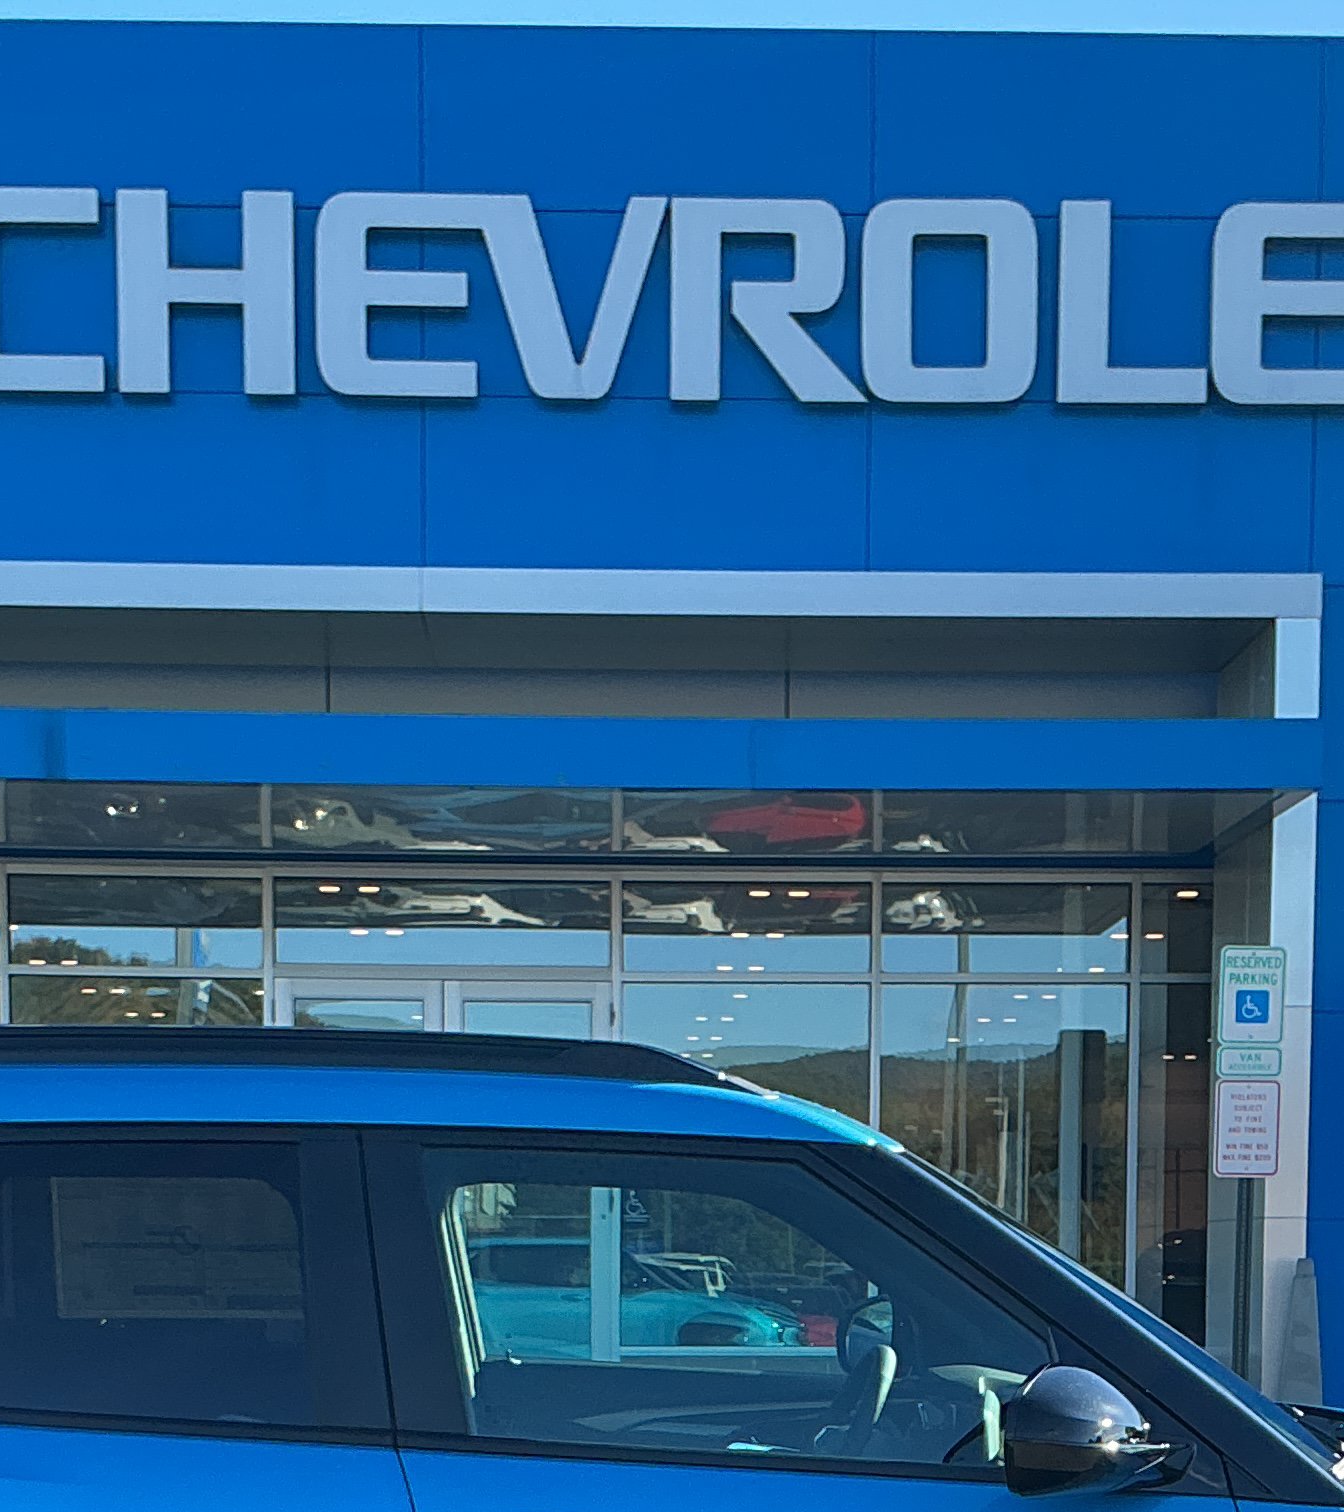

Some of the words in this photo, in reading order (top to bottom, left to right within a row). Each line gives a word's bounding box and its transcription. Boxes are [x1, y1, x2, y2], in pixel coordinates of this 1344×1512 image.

[1226, 956, 1282, 969] RESERVED
[1229, 973, 1279, 986] PARKING
[1239, 1053, 1262, 1062] VAN
